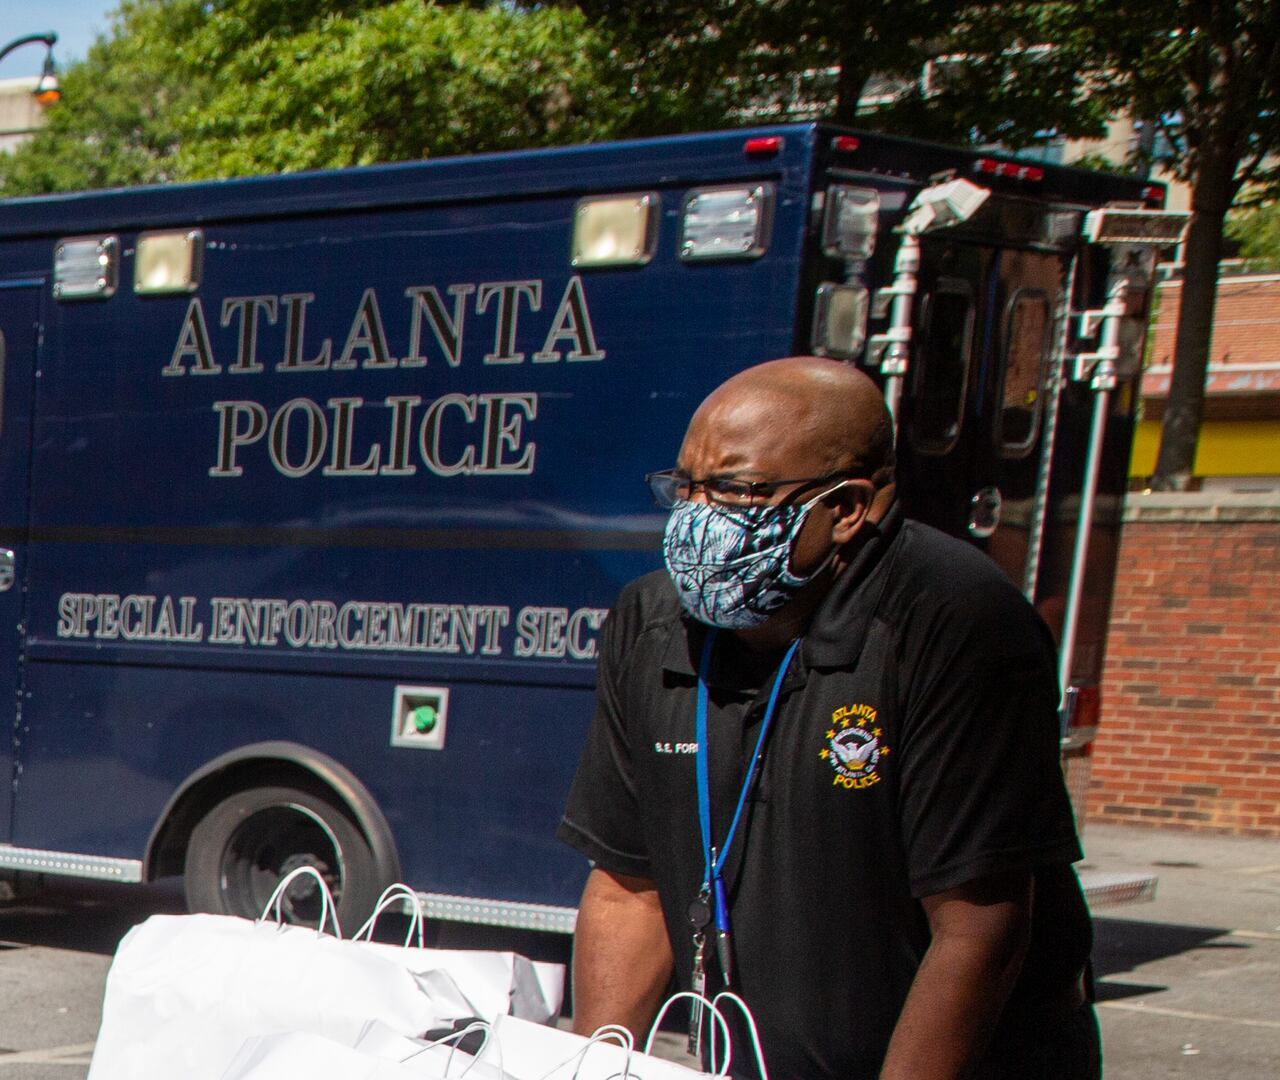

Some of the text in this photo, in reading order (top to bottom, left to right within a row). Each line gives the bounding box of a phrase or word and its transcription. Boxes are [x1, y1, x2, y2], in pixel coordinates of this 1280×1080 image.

[161, 275, 606, 377] ATLANTA
[209, 393, 538, 477] POLICE
[57, 592, 203, 643] SPECIAL
[207, 597, 510, 656] ENFORCEMENT
[831, 703, 878, 724] ATLANTA
[674, 742, 699, 754] FOR
[833, 771, 881, 788] POLICE
